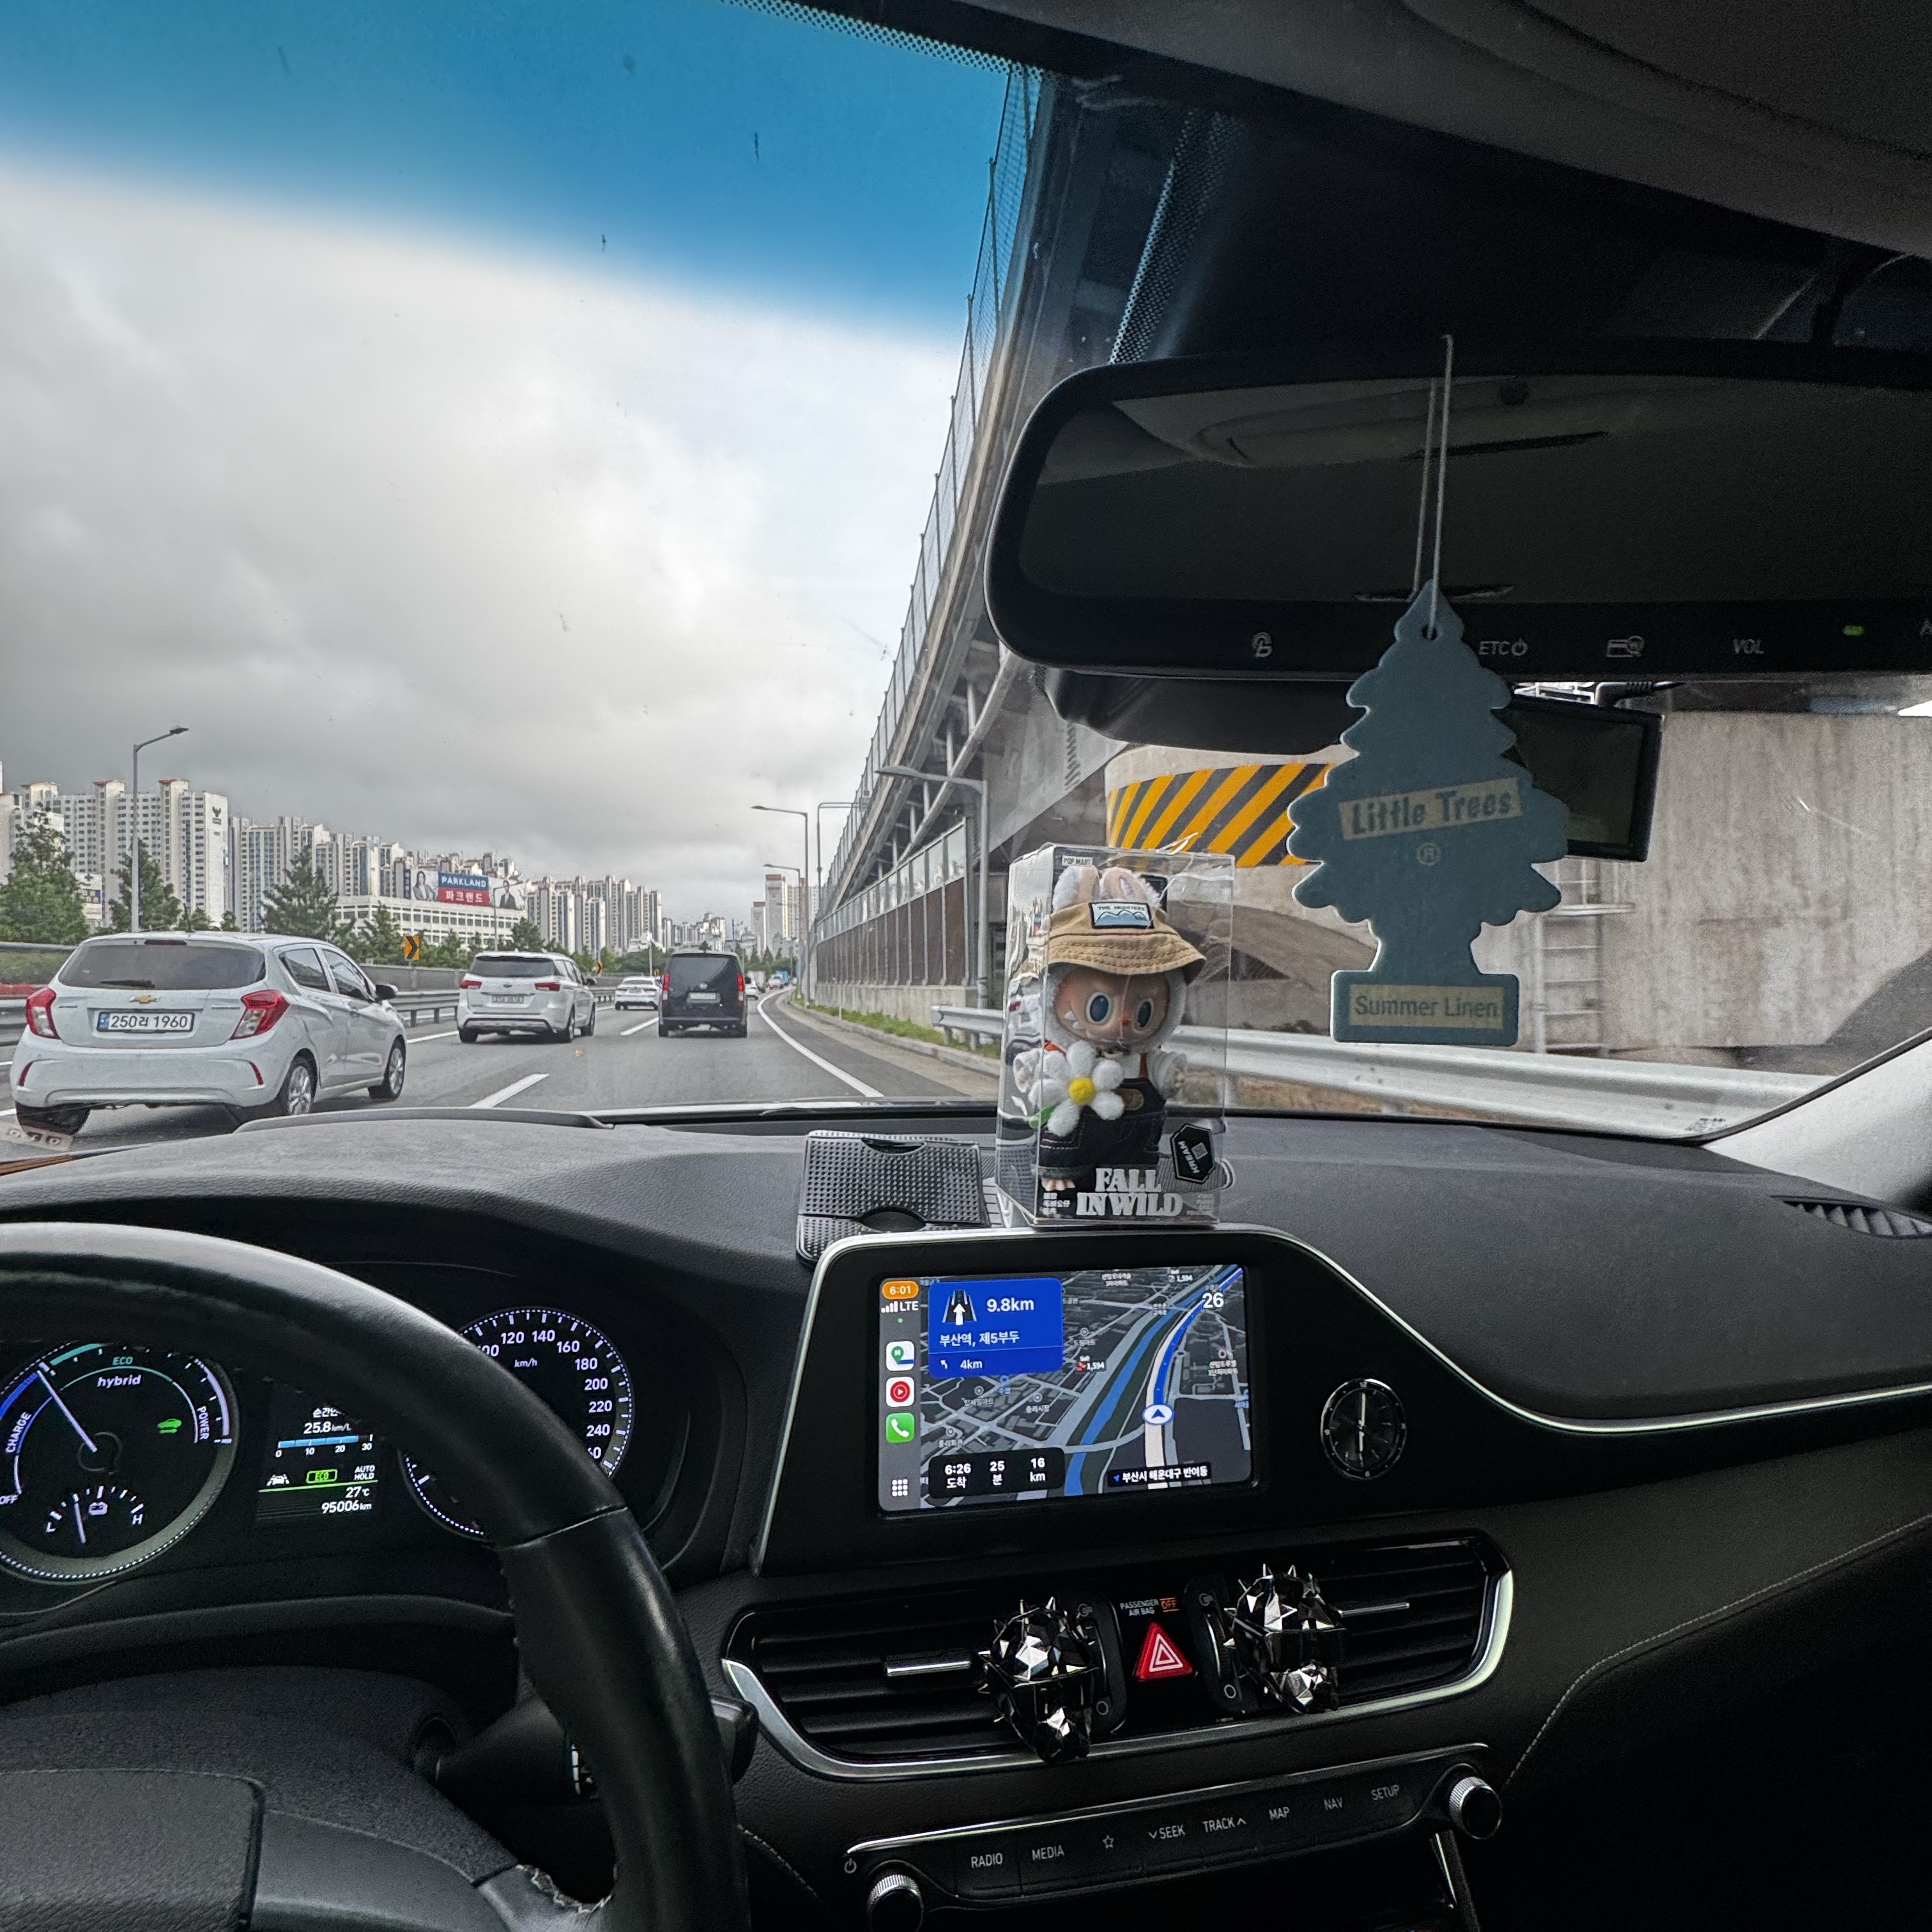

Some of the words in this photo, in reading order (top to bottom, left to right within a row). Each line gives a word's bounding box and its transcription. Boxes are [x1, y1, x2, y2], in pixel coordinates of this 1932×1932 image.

[1479, 641, 1510, 655] ETC
[1733, 639, 1764, 654] VOL
[1352, 797, 1426, 834] Little
[1436, 790, 1511, 822] Trees
[441, 876, 486, 887] PARKLAND
[445, 890, 483, 903] 파크랜드
[1354, 995, 1438, 1016] Summer
[1445, 997, 1498, 1017] Linen
[154, 1015, 188, 1028] 1960
[1177, 1140, 1200, 1173] KREAM
[1095, 1168, 1162, 1192] FALL
[889, 1285, 911, 1295] 6:01
[900, 1301, 919, 1312] LTE
[986, 1298, 1034, 1313] 9.8km
[1202, 1292, 1224, 1308] 26
[500, 1331, 525, 1344] 120
[532, 1330, 555, 1342] 140
[940, 1334, 976, 1347] 부산역,
[979, 1331, 1020, 1346] 제5부두
[478, 1344, 499, 1356] 00
[556, 1340, 580, 1354] 160
[112, 1356, 133, 1365] ECO
[514, 1358, 537, 1367] km/h
[575, 1358, 598, 1370] 180
[960, 1359, 983, 1369] 4km
[1086, 1361, 1105, 1371] 1,594
[97, 1375, 141, 1388] hybrid
[584, 1377, 608, 1391] 200
[588, 1400, 612, 1413] 220
[197, 1406, 210, 1441] POWER
[586, 1423, 610, 1437] 240
[5, 1412, 31, 1453] CHARGE
[305, 1447, 315, 1455] 10
[335, 1445, 346, 1453] 20
[362, 1443, 372, 1451] 30
[944, 1464, 971, 1475] 6:26
[990, 1460, 1005, 1471] 25
[1030, 1458, 1045, 1468] 16
[315, 1471, 329, 1481] ECO
[992, 1474, 1002, 1485] 분
[1030, 1472, 1046, 1482] km
[1122, 1470, 1147, 1483] 부산시
[1149, 1468, 1181, 1481] 해운대구
[1183, 1466, 1208, 1478] 반여동
[946, 1477, 967, 1489] 도착
[0, 1494, 18, 1505] OFF
[132, 1514, 142, 1525] H
[1120, 1599, 1159, 1610] PASSENGER
[1161, 1599, 1177, 1609] OFF
[1370, 1784, 1400, 1801] SETUP
[1324, 1797, 1342, 1811] NAV
[1269, 1806, 1289, 1820] MAP
[1203, 1817, 1236, 1833] TRACK
[1159, 1825, 1186, 1839] SEEK
[1032, 1845, 1065, 1861] MEDIA
[970, 1852, 1003, 1869] RADIO
